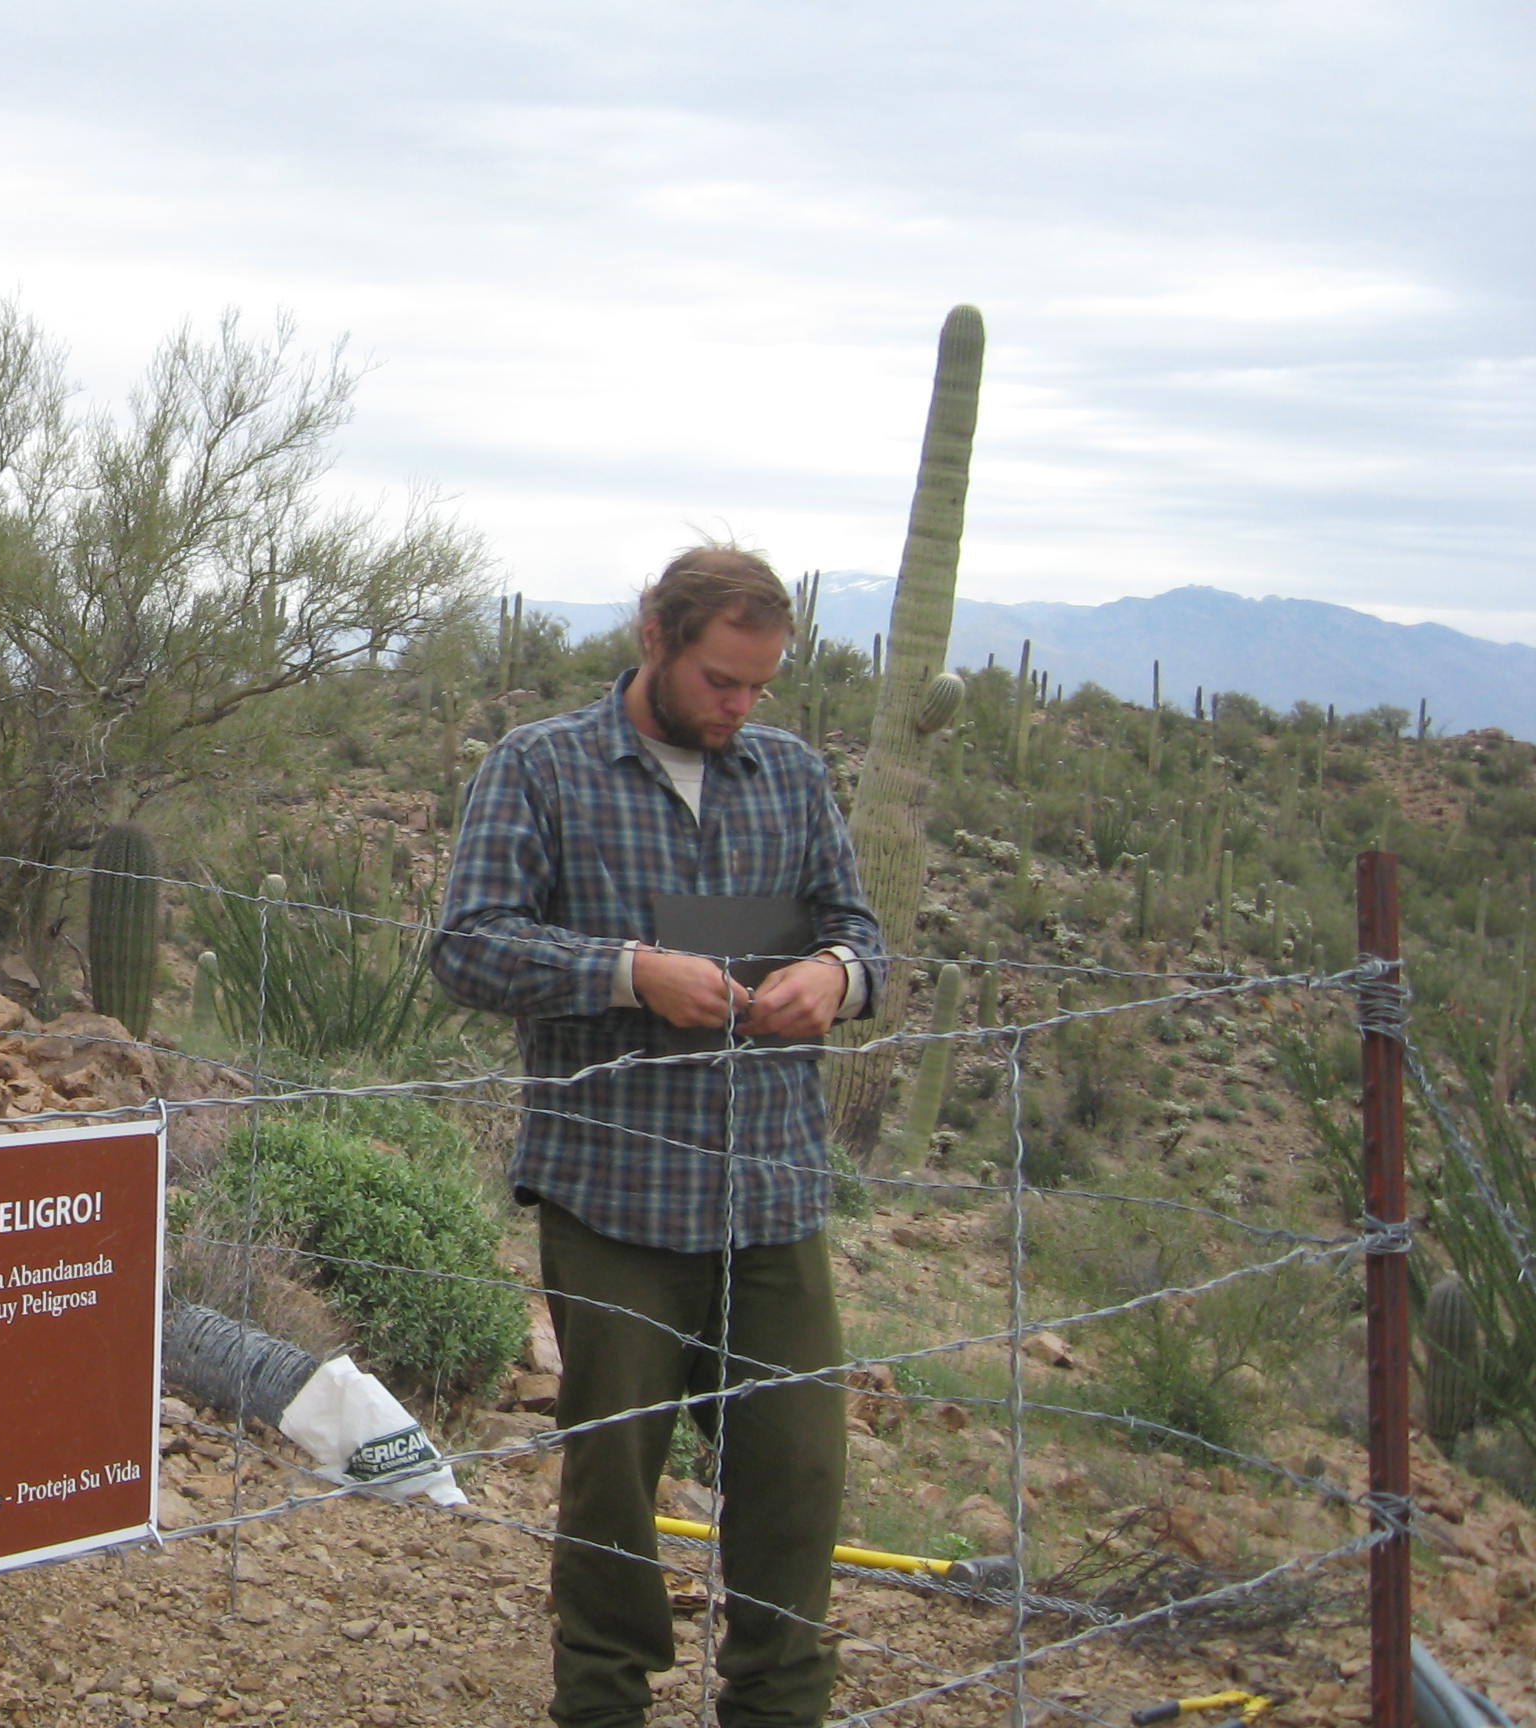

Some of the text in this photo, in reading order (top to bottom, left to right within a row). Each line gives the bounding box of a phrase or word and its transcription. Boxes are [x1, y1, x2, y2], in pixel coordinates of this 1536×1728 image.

[7, 1254, 114, 1289] Abandanada
[21, 1290, 97, 1318] Peligrosa
[16, 1474, 77, 1505] Proteja
[79, 1470, 101, 1491] Su
[104, 1460, 141, 1485] Vida
